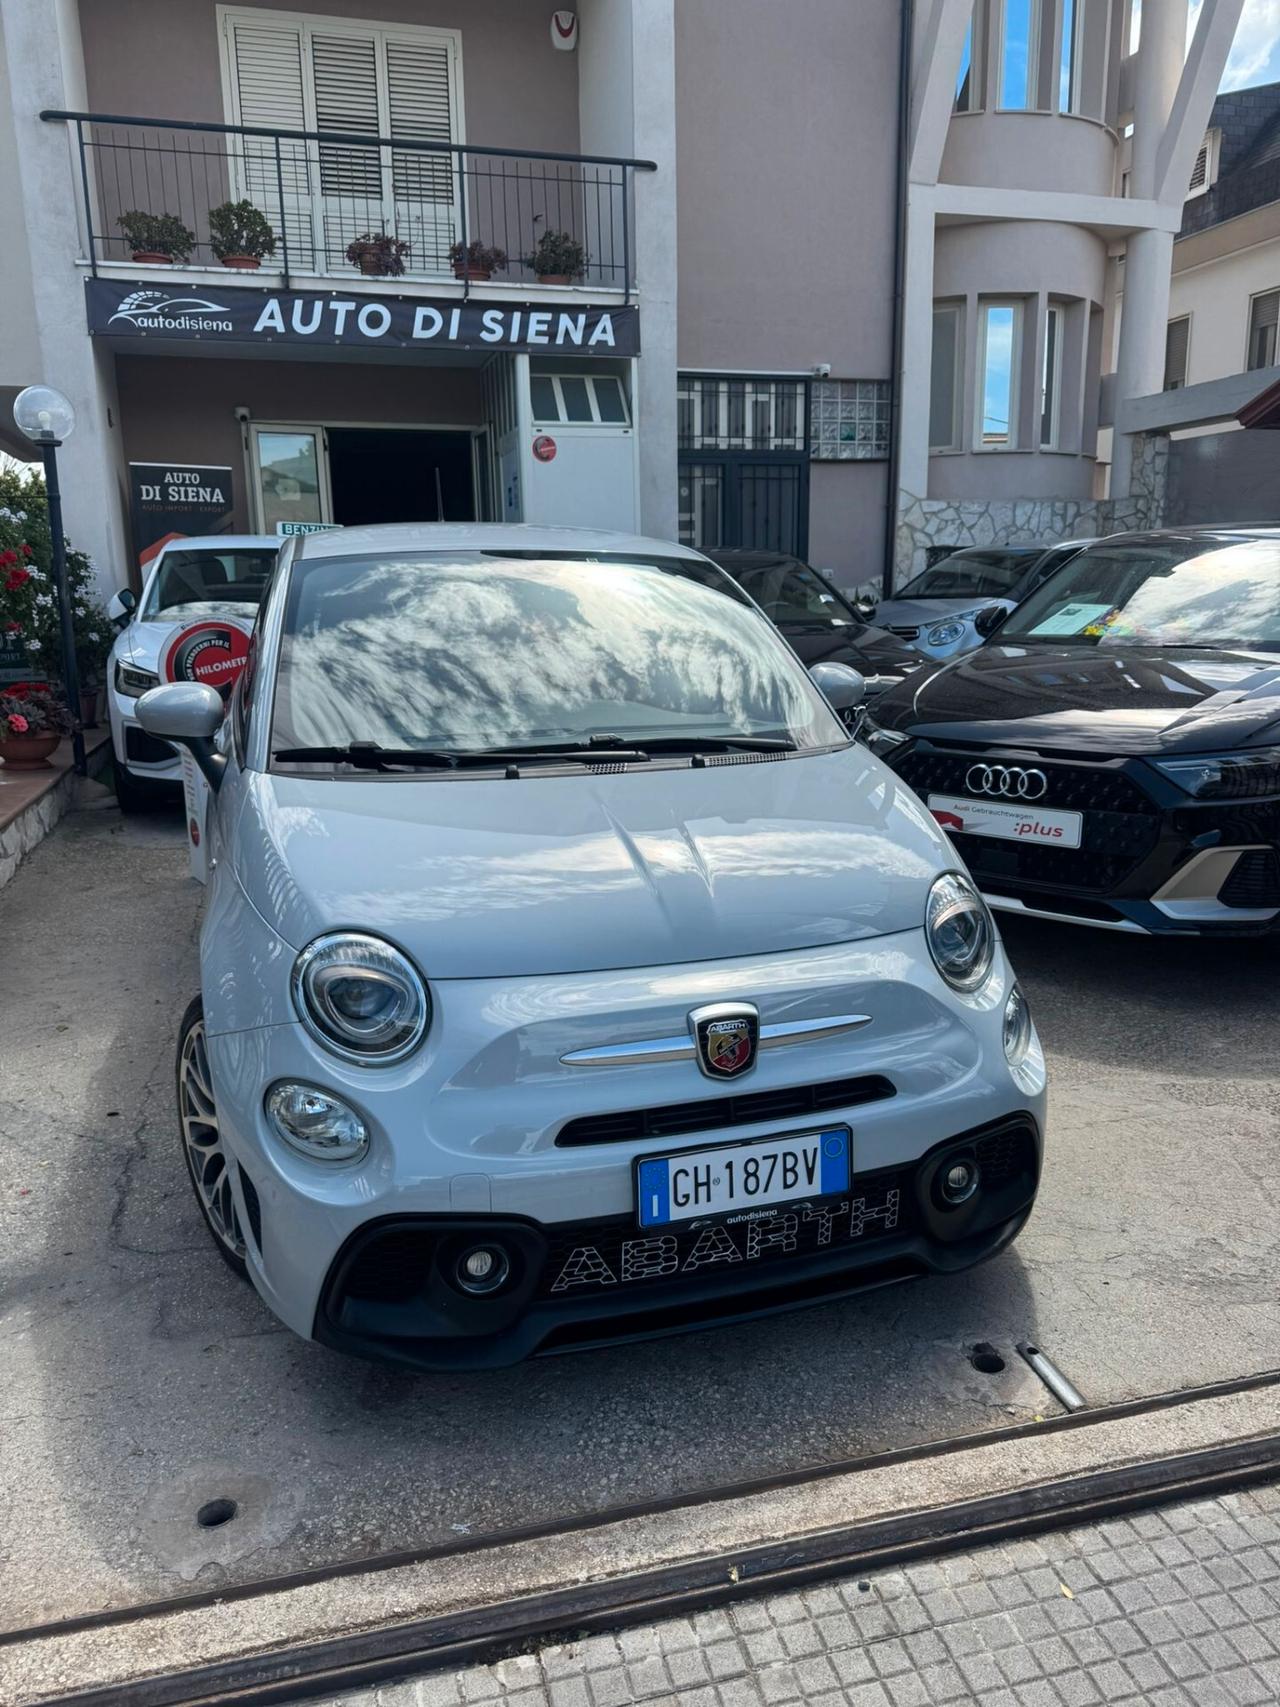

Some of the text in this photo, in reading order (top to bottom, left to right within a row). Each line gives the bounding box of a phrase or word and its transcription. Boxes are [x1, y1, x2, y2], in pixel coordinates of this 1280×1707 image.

[137, 315, 233, 332] autodisiena
[253, 298, 616, 347] AUTO DI SIENA
[163, 472, 201, 484] AUTO
[140, 485, 225, 503] DI SIENA
[953, 804, 1034, 820] Audi Gebrauchtwagen
[726, 1208, 778, 1225] autodisiena
[550, 1188, 900, 1292] ABARTH
